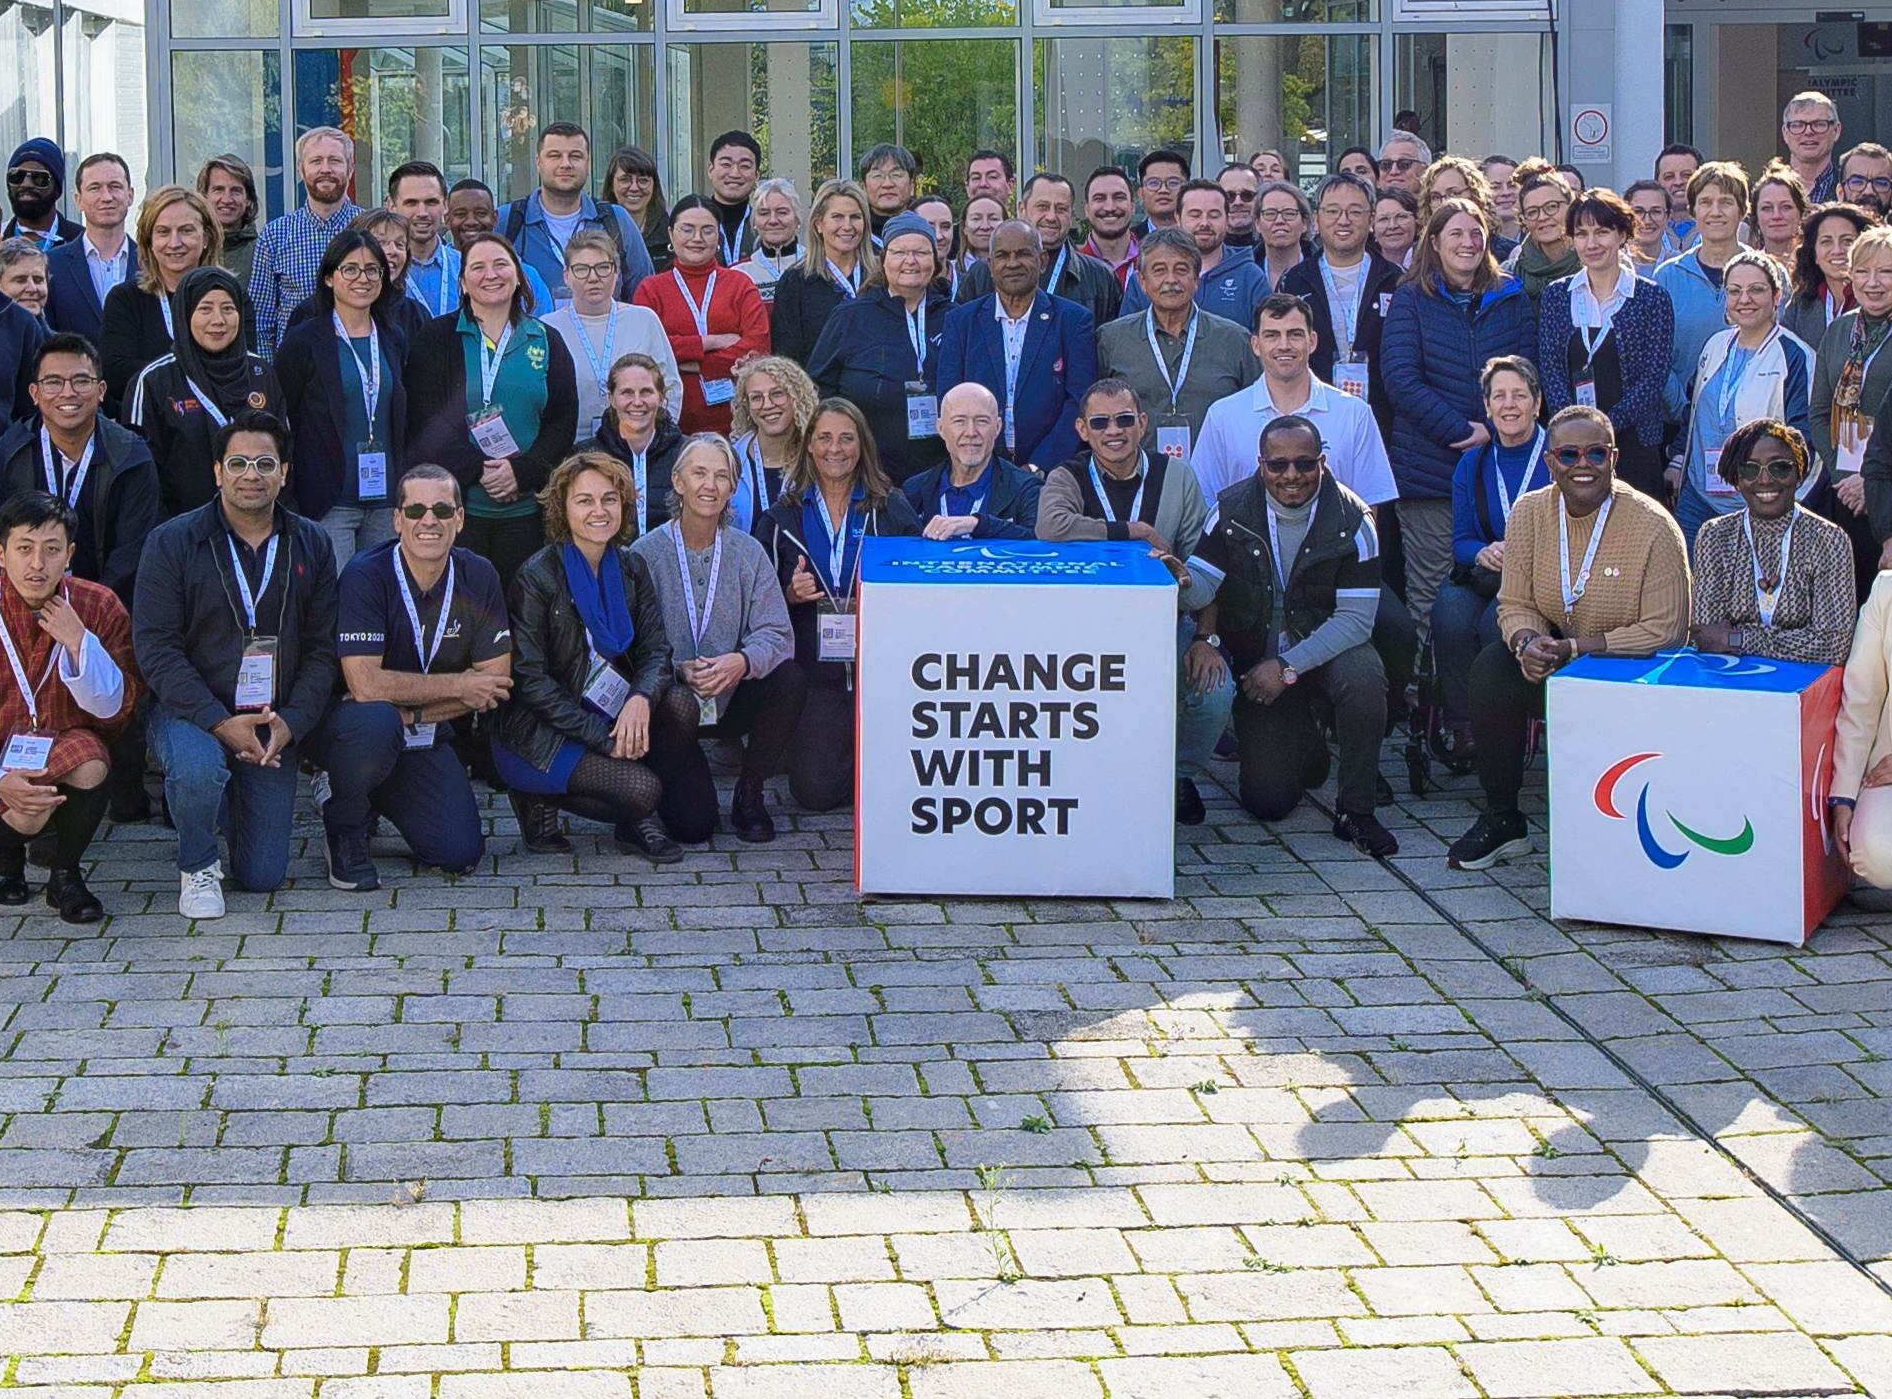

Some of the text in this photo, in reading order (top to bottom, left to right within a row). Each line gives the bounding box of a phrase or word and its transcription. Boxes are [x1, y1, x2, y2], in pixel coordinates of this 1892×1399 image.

[339, 632, 385, 642] TOKYO 2020
[911, 653, 1126, 692] CHANGE
[912, 701, 1100, 740] STARTS
[910, 750, 1051, 787] WITH
[911, 797, 1079, 836] SPORT
